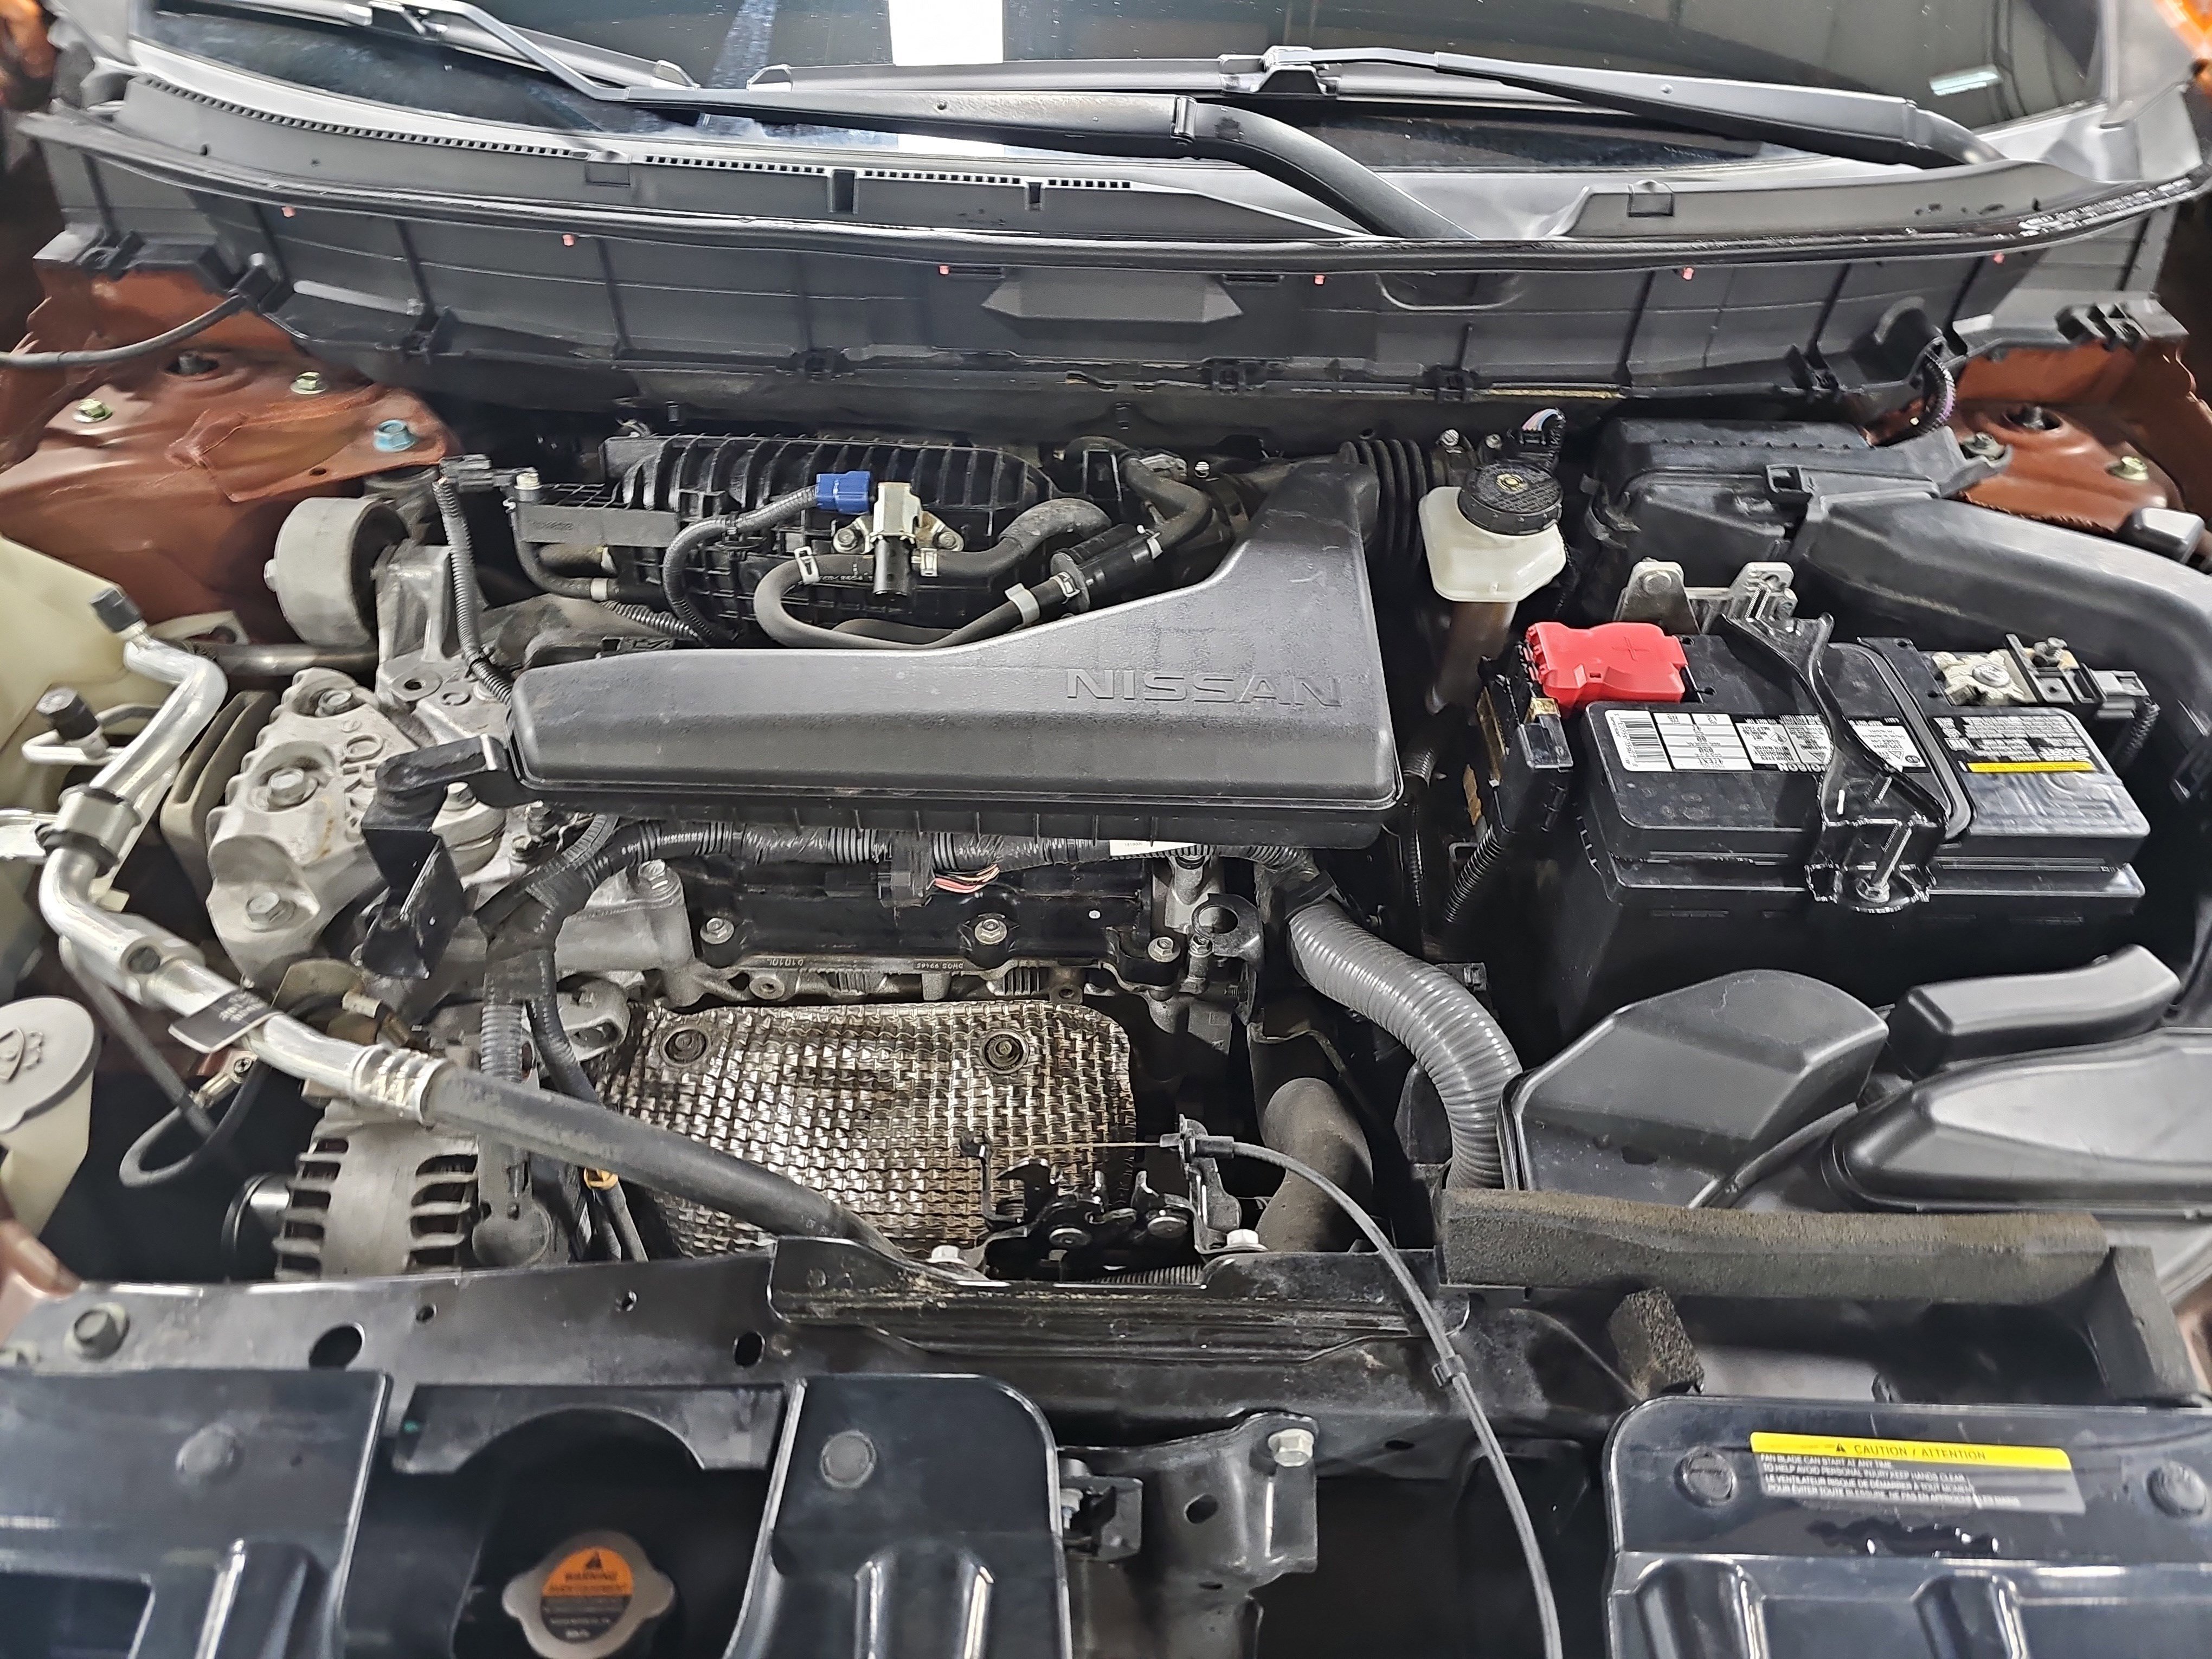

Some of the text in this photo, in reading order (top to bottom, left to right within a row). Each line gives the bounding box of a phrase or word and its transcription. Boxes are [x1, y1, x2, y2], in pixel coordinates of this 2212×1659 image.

[1067, 668, 1343, 707] NISSAN
[1854, 1445, 1907, 1456] CAUTION
[1922, 1449, 1986, 1460] ATTENTION
[1777, 1455, 1802, 1464] BLADE
[1803, 1456, 1821, 1465] CAN
[1822, 1457, 1846, 1466] START
[1847, 1458, 1856, 1467] AT
[1858, 1459, 1874, 1468] ANY
[1763, 1463, 1774, 1472] TO
[1775, 1464, 1795, 1473] HELP
[1797, 1465, 1820, 1475] AVOID
[1821, 1467, 1862, 1477] PERSONAL
[1777, 1475, 1826, 1486] VENTILATEUR
[1858, 1479, 1869, 1488] DE
